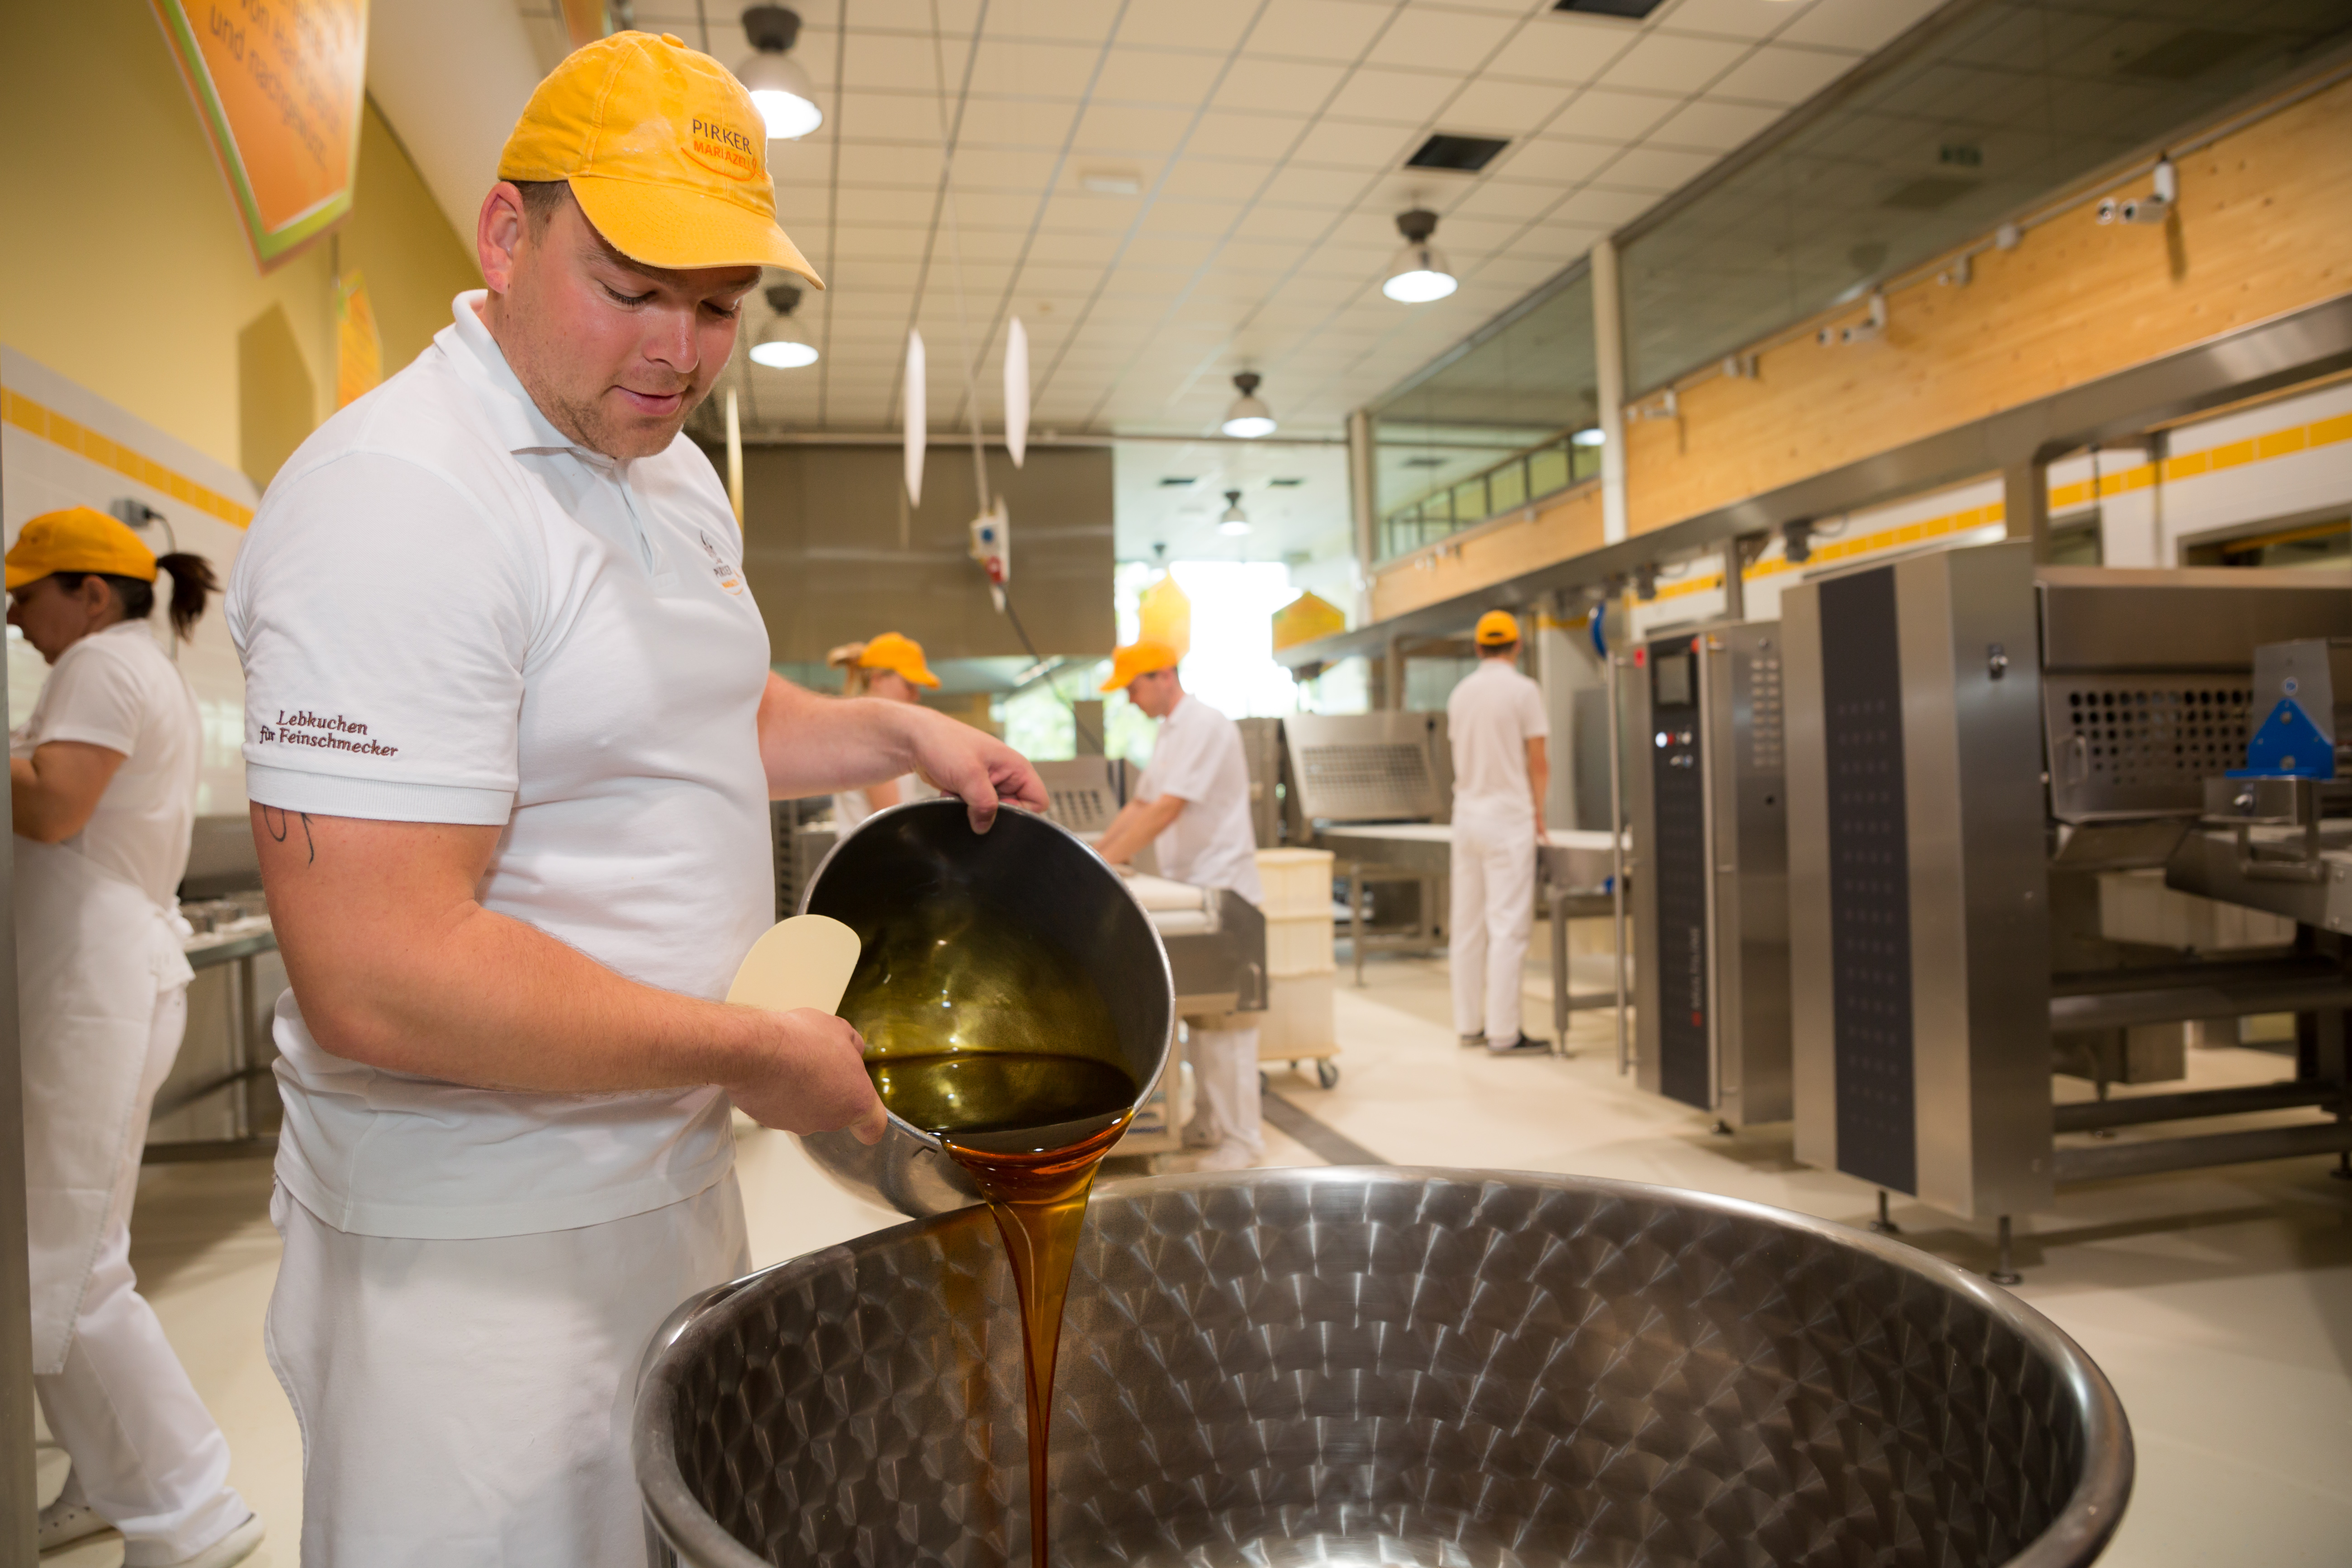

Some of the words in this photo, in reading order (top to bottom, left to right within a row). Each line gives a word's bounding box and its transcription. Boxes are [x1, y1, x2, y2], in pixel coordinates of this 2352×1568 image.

[210, 5, 246, 62] und
[693, 118, 752, 155] PIRKER
[276, 710, 367, 735] Lebkuchen
[260, 725, 275, 744] für
[280, 727, 398, 757] Feinschmecker
